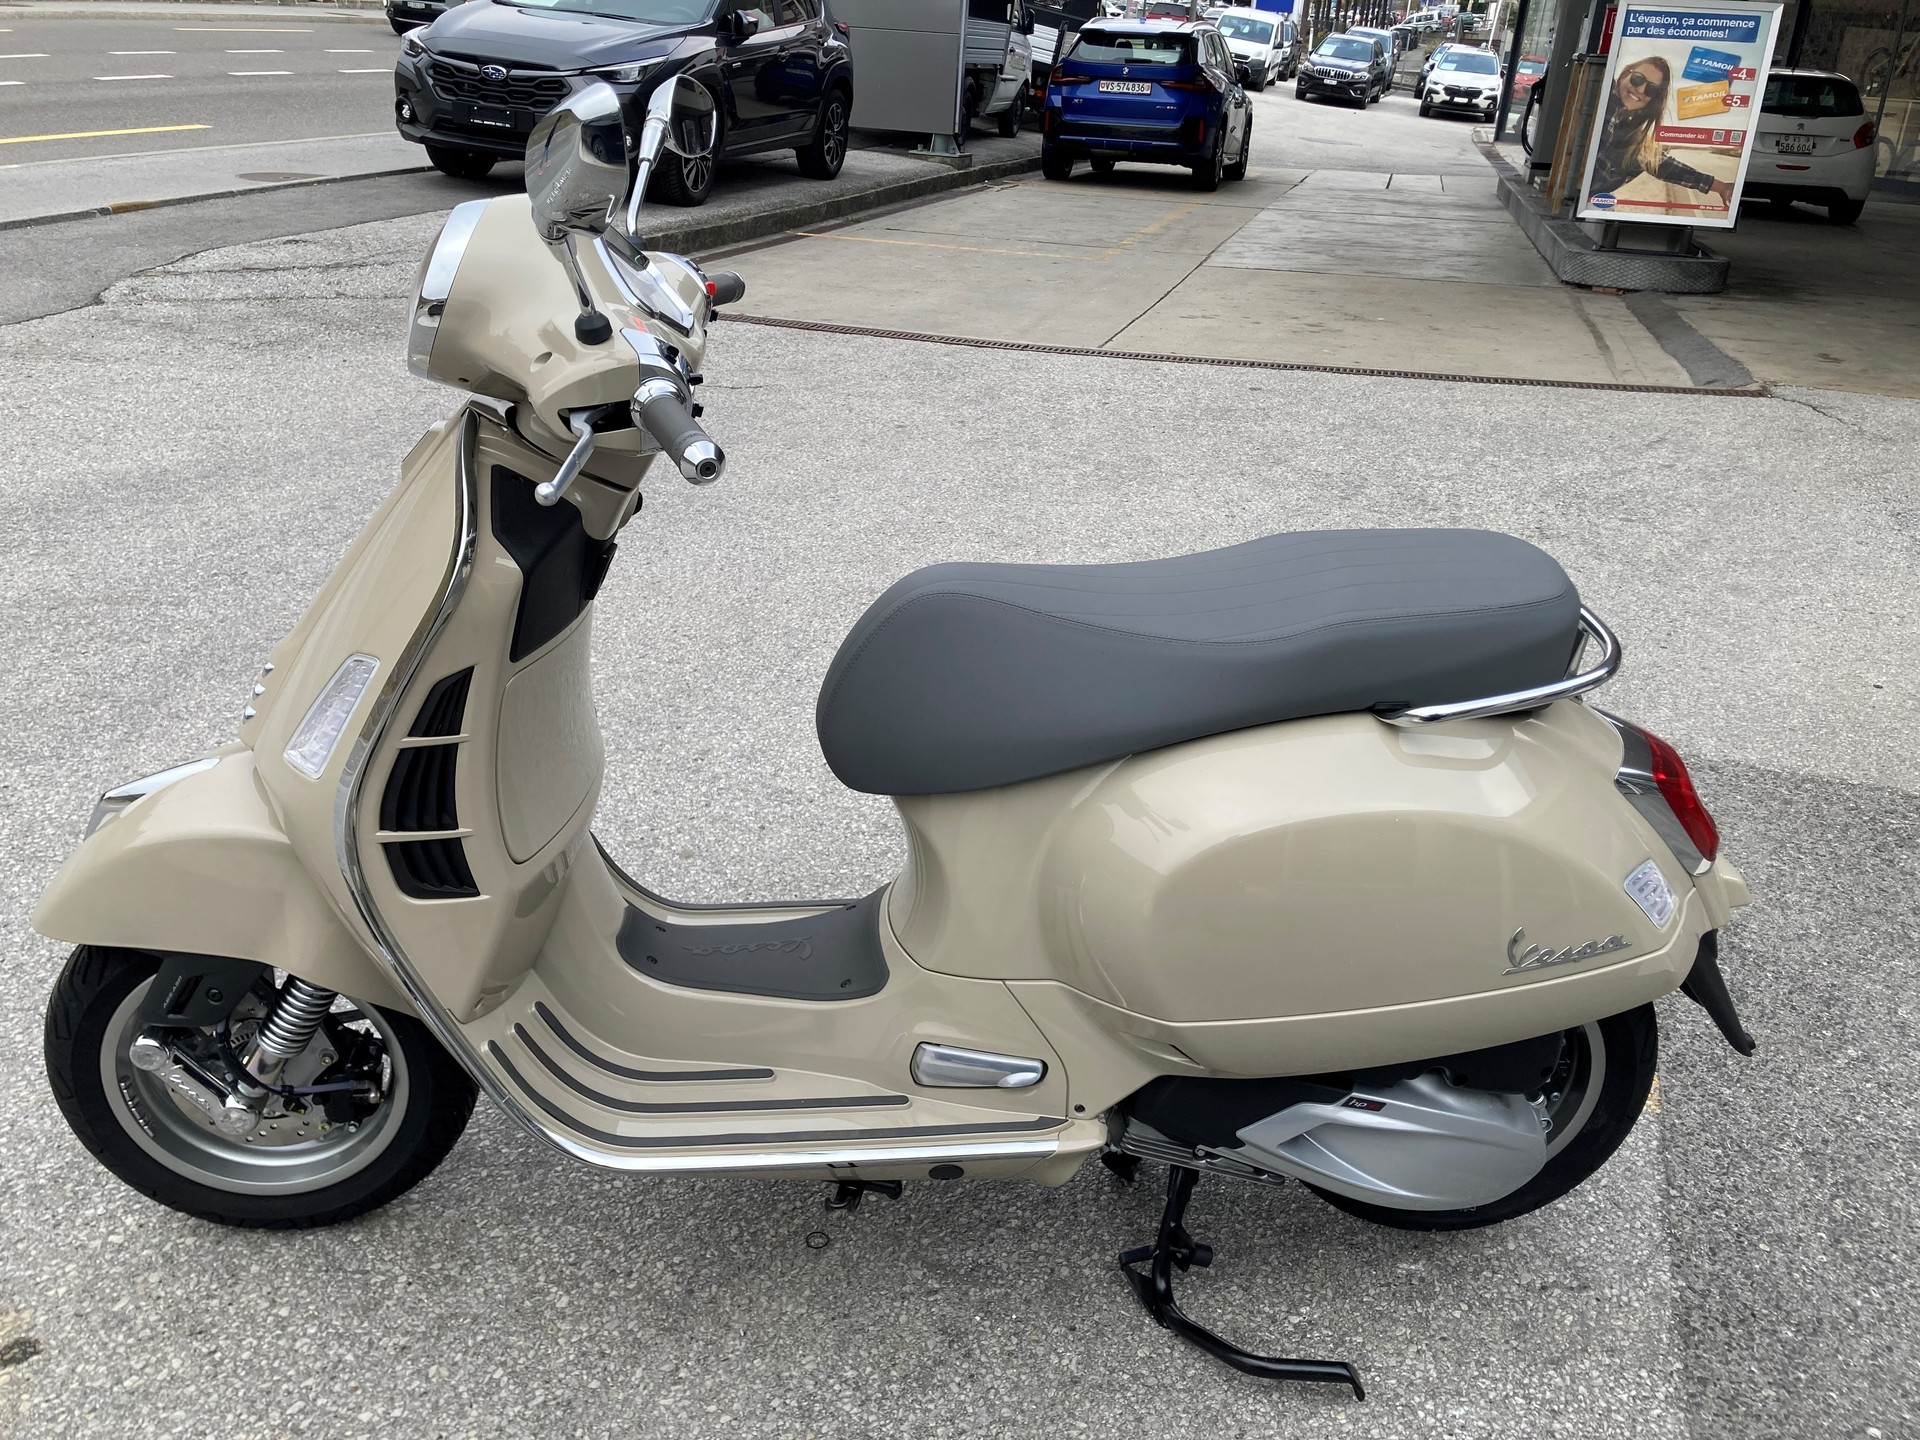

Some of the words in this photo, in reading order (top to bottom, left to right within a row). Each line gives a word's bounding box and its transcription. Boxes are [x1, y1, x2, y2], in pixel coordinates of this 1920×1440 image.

[1629, 12, 1679, 25] L'évasion,
[1682, 17, 1694, 27] ça
[1697, 18, 1755, 28] commence
[1627, 26, 1644, 35] par
[1646, 25, 1665, 35] des
[1667, 27, 1729, 38] économies!
[1691, 90, 1727, 102] TAMOIL
[1660, 131, 1696, 139] Commander
[1501, 926, 1633, 976] Vespa
